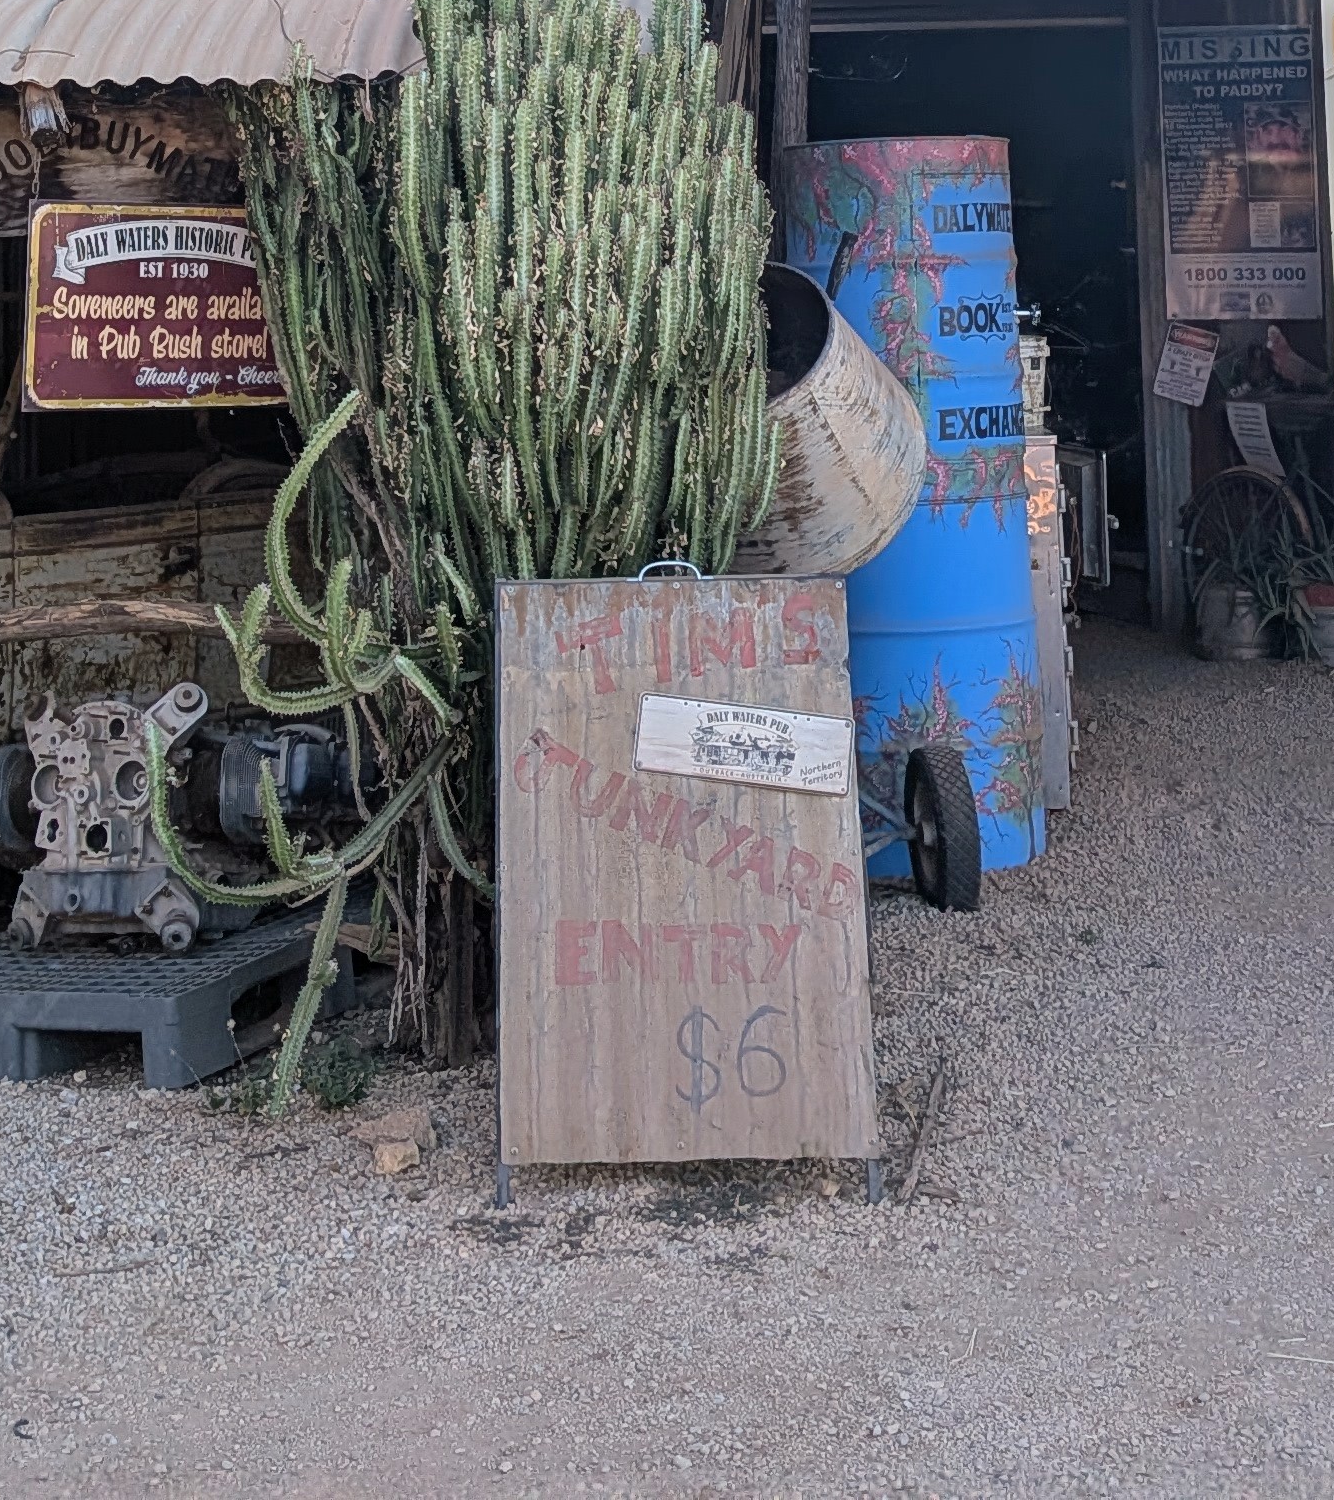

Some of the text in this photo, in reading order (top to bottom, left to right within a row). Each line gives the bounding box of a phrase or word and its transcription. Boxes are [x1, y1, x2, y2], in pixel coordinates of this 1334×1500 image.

[1163, 66, 1308, 83] WHAT HAPPENED
[1194, 83, 1284, 98] TO PADDY?
[75, 233, 109, 262] DALY
[116, 225, 169, 253] WATERS
[174, 226, 238, 258] HISTORIC
[139, 262, 209, 278] EST 1930
[1184, 267, 1307, 282] 1800 333 000
[53, 286, 156, 320] Soveneers
[165, 294, 198, 320] are
[939, 303, 1003, 337] BOOK
[71, 325, 89, 359] in
[99, 325, 141, 359] Pub
[151, 325, 202, 359] Bush
[136, 366, 187, 385] Thank
[187, 374, 220, 393] you
[555, 589, 821, 695] TIMS
[707, 711, 790, 735] DALY WATERS PUB
[799, 760, 842, 777] Northern
[801, 770, 843, 787] Territory
[555, 919, 804, 986] ENTRY
[675, 1003, 788, 1115] $6
